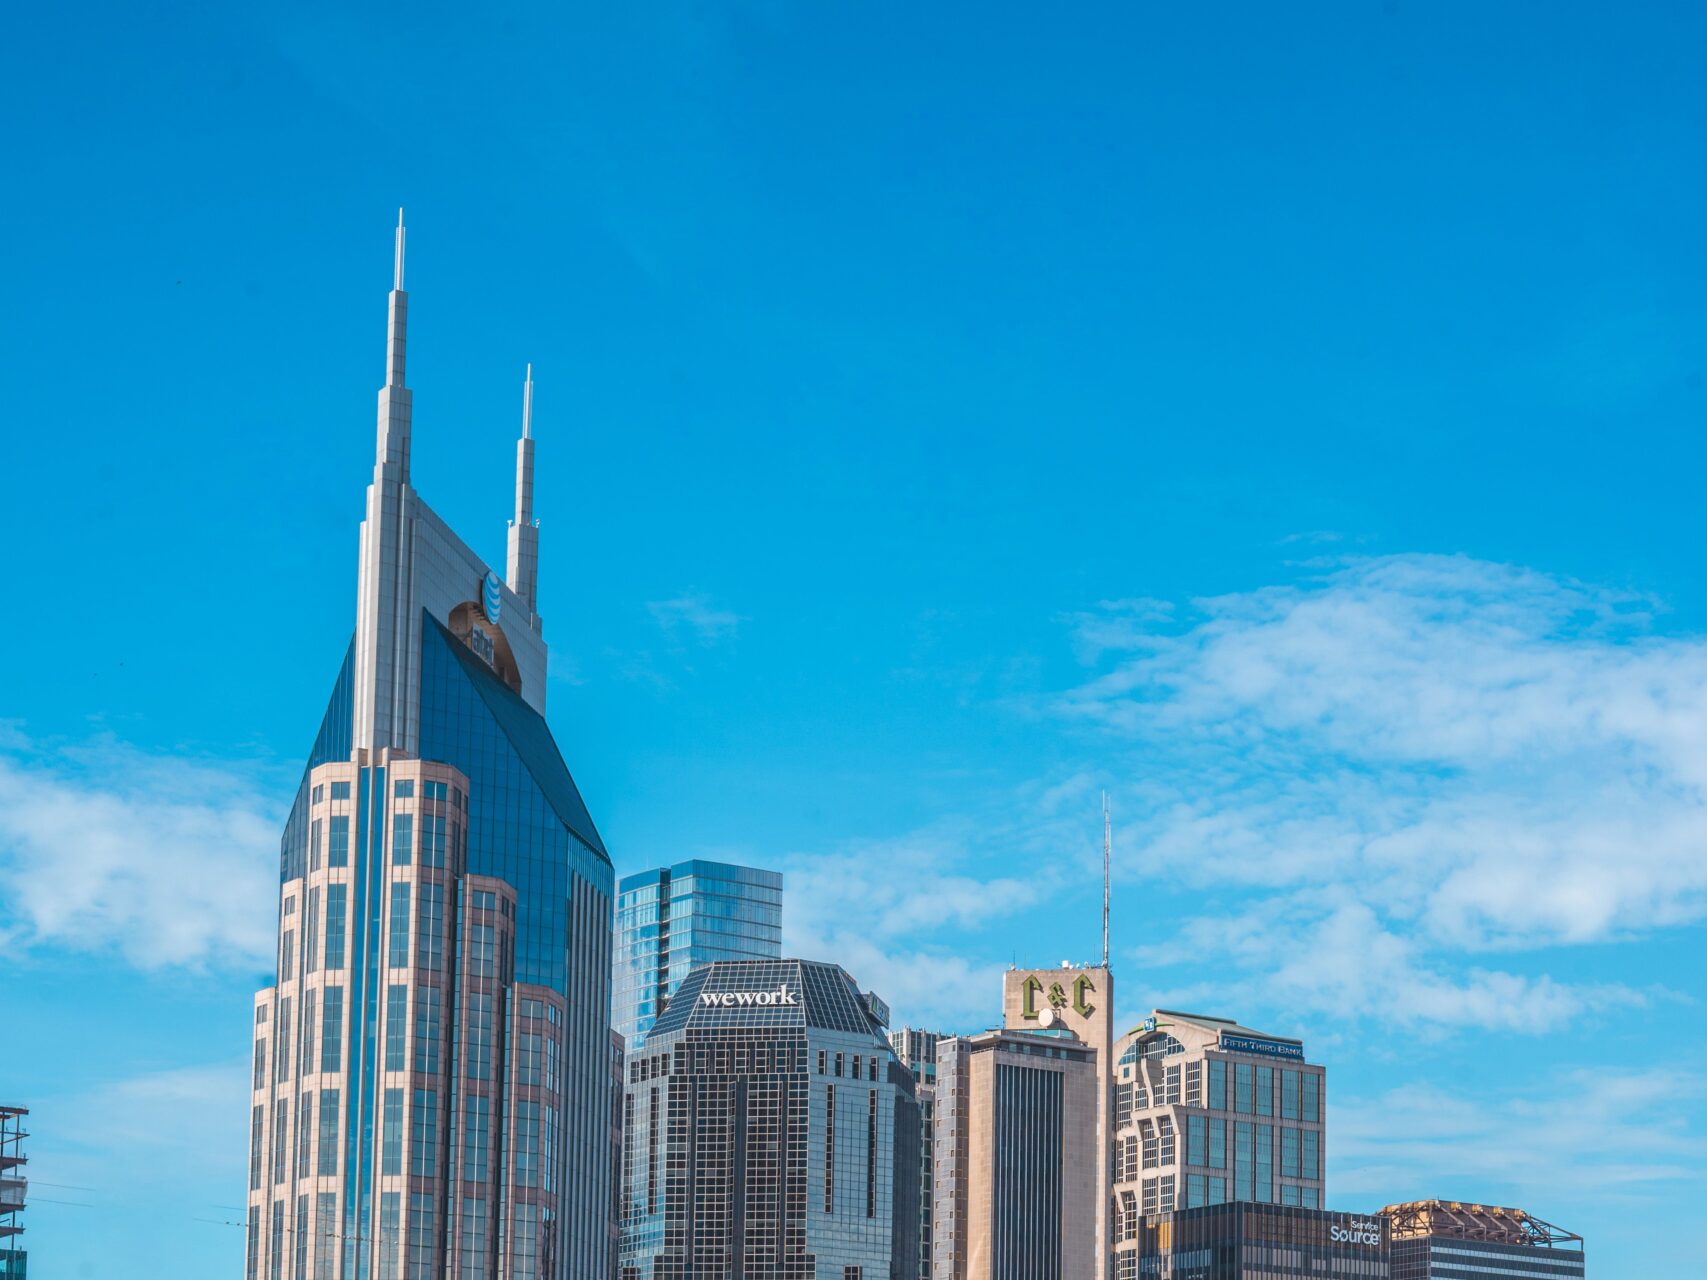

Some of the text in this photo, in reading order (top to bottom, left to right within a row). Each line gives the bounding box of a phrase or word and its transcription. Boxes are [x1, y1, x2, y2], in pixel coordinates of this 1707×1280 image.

[701, 984, 798, 1006] wework
[1224, 1037, 1302, 1056] FIFTH THIRD BANK
[1330, 1225, 1379, 1246] Source
[1351, 1220, 1379, 1231] Service
